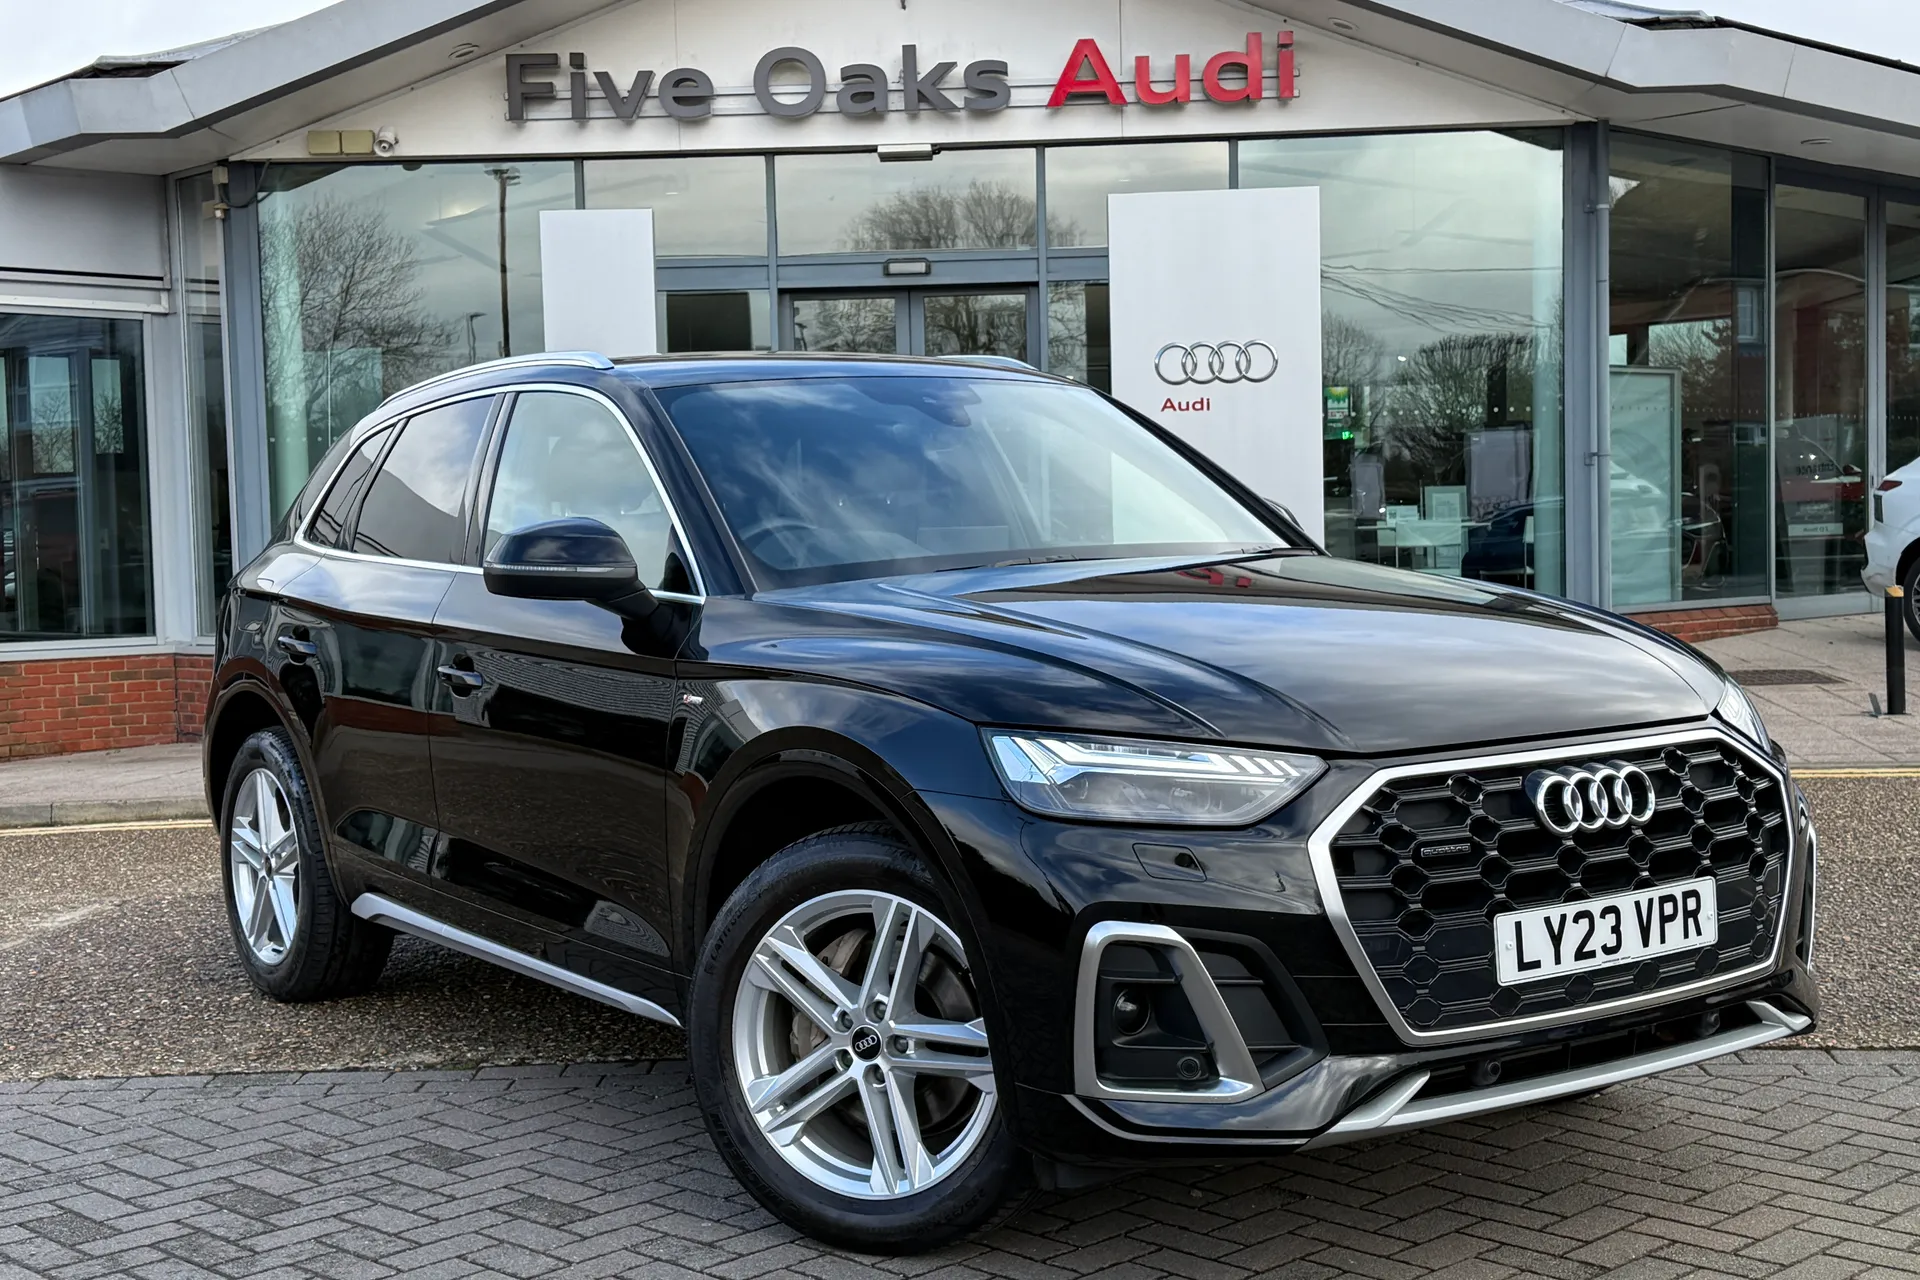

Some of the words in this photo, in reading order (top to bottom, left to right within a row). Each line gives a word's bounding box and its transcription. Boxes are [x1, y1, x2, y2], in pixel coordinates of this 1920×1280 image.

[505, 52, 715, 122] Five
[753, 44, 1011, 119] Oaks
[1046, 30, 1296, 108] Audi
[1161, 397, 1211, 412] Audi
[1423, 845, 1469, 856] quattro
[1514, 905, 1623, 973] LY23
[1633, 889, 1703, 949] VPR
